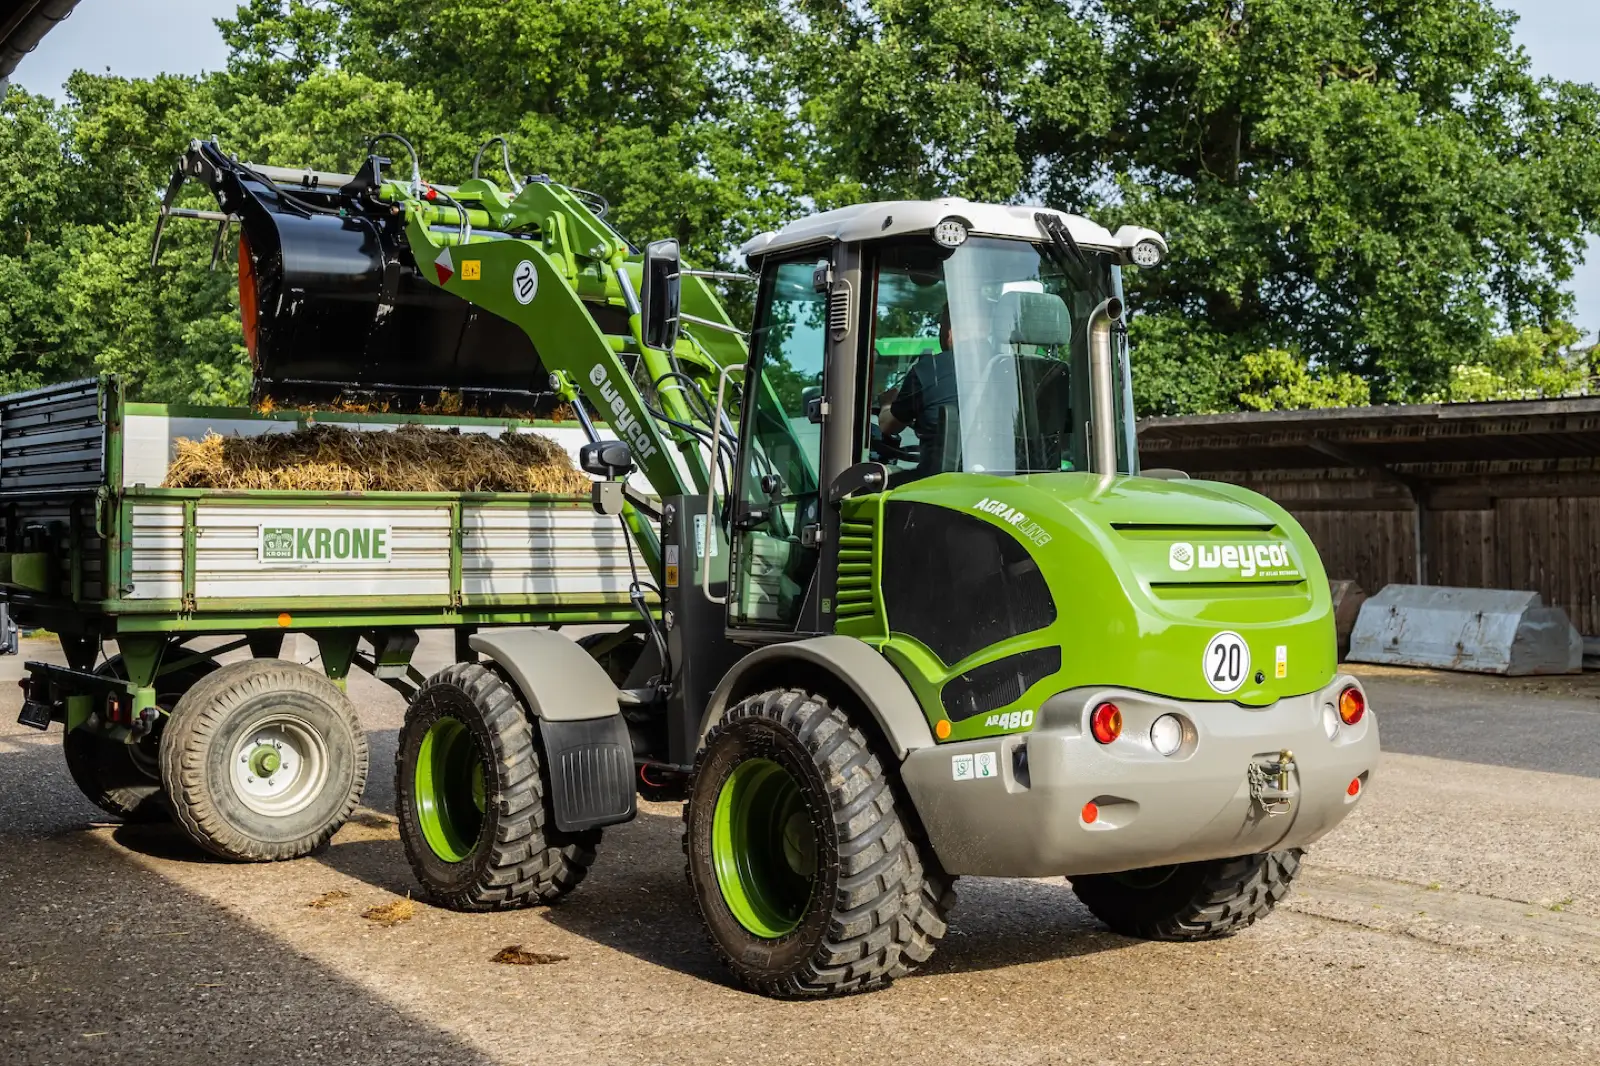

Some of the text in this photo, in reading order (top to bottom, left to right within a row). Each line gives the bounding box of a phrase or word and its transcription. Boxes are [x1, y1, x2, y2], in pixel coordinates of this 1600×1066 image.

[516, 266, 534, 298] 20
[599, 379, 658, 459] weycor
[296, 527, 387, 559] KRONE
[1197, 544, 1290, 577] weycor
[1213, 643, 1240, 682] 20
